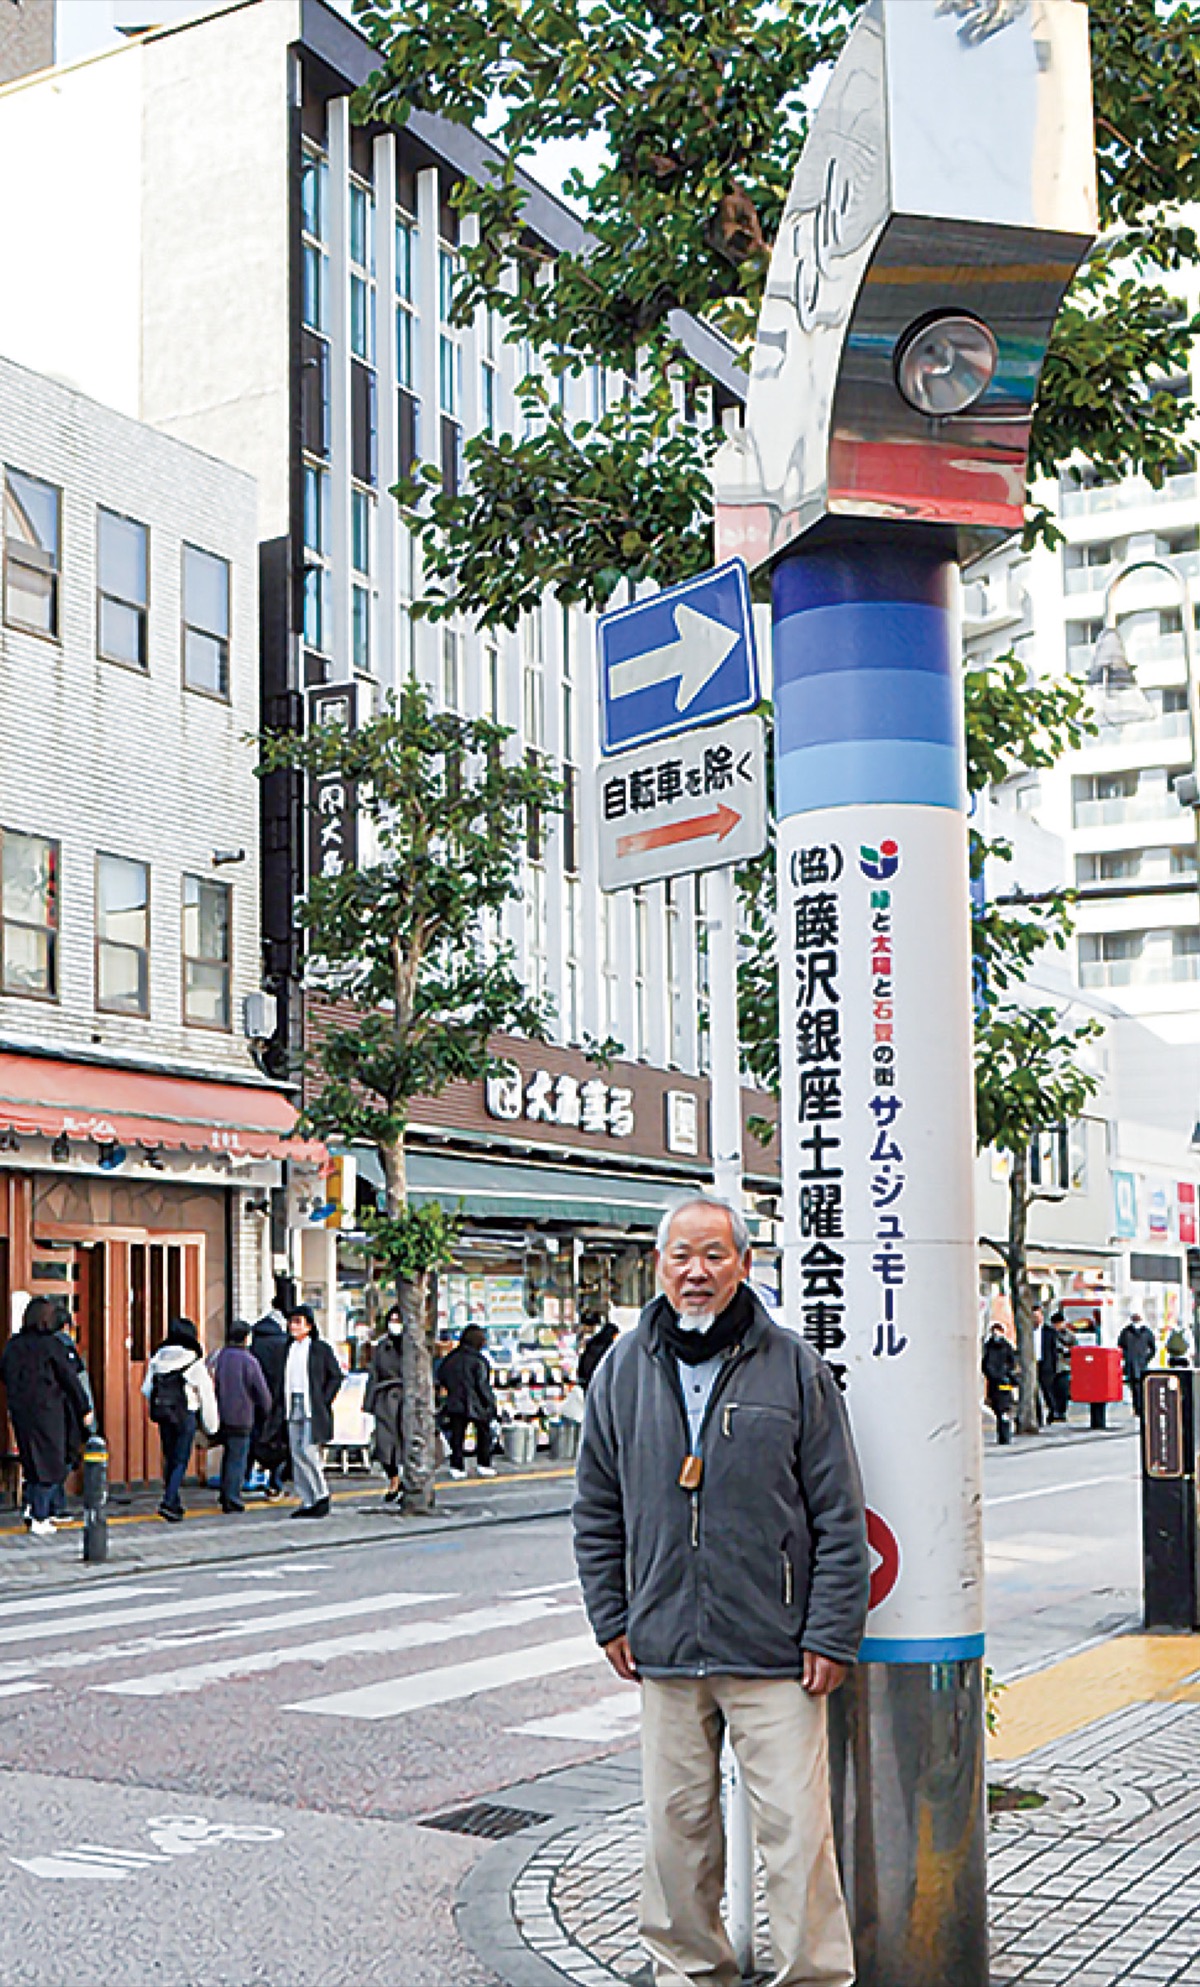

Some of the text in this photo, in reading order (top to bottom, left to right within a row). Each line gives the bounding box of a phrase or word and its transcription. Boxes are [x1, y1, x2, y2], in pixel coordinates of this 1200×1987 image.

[604, 745, 752, 821] 自転車を除く
